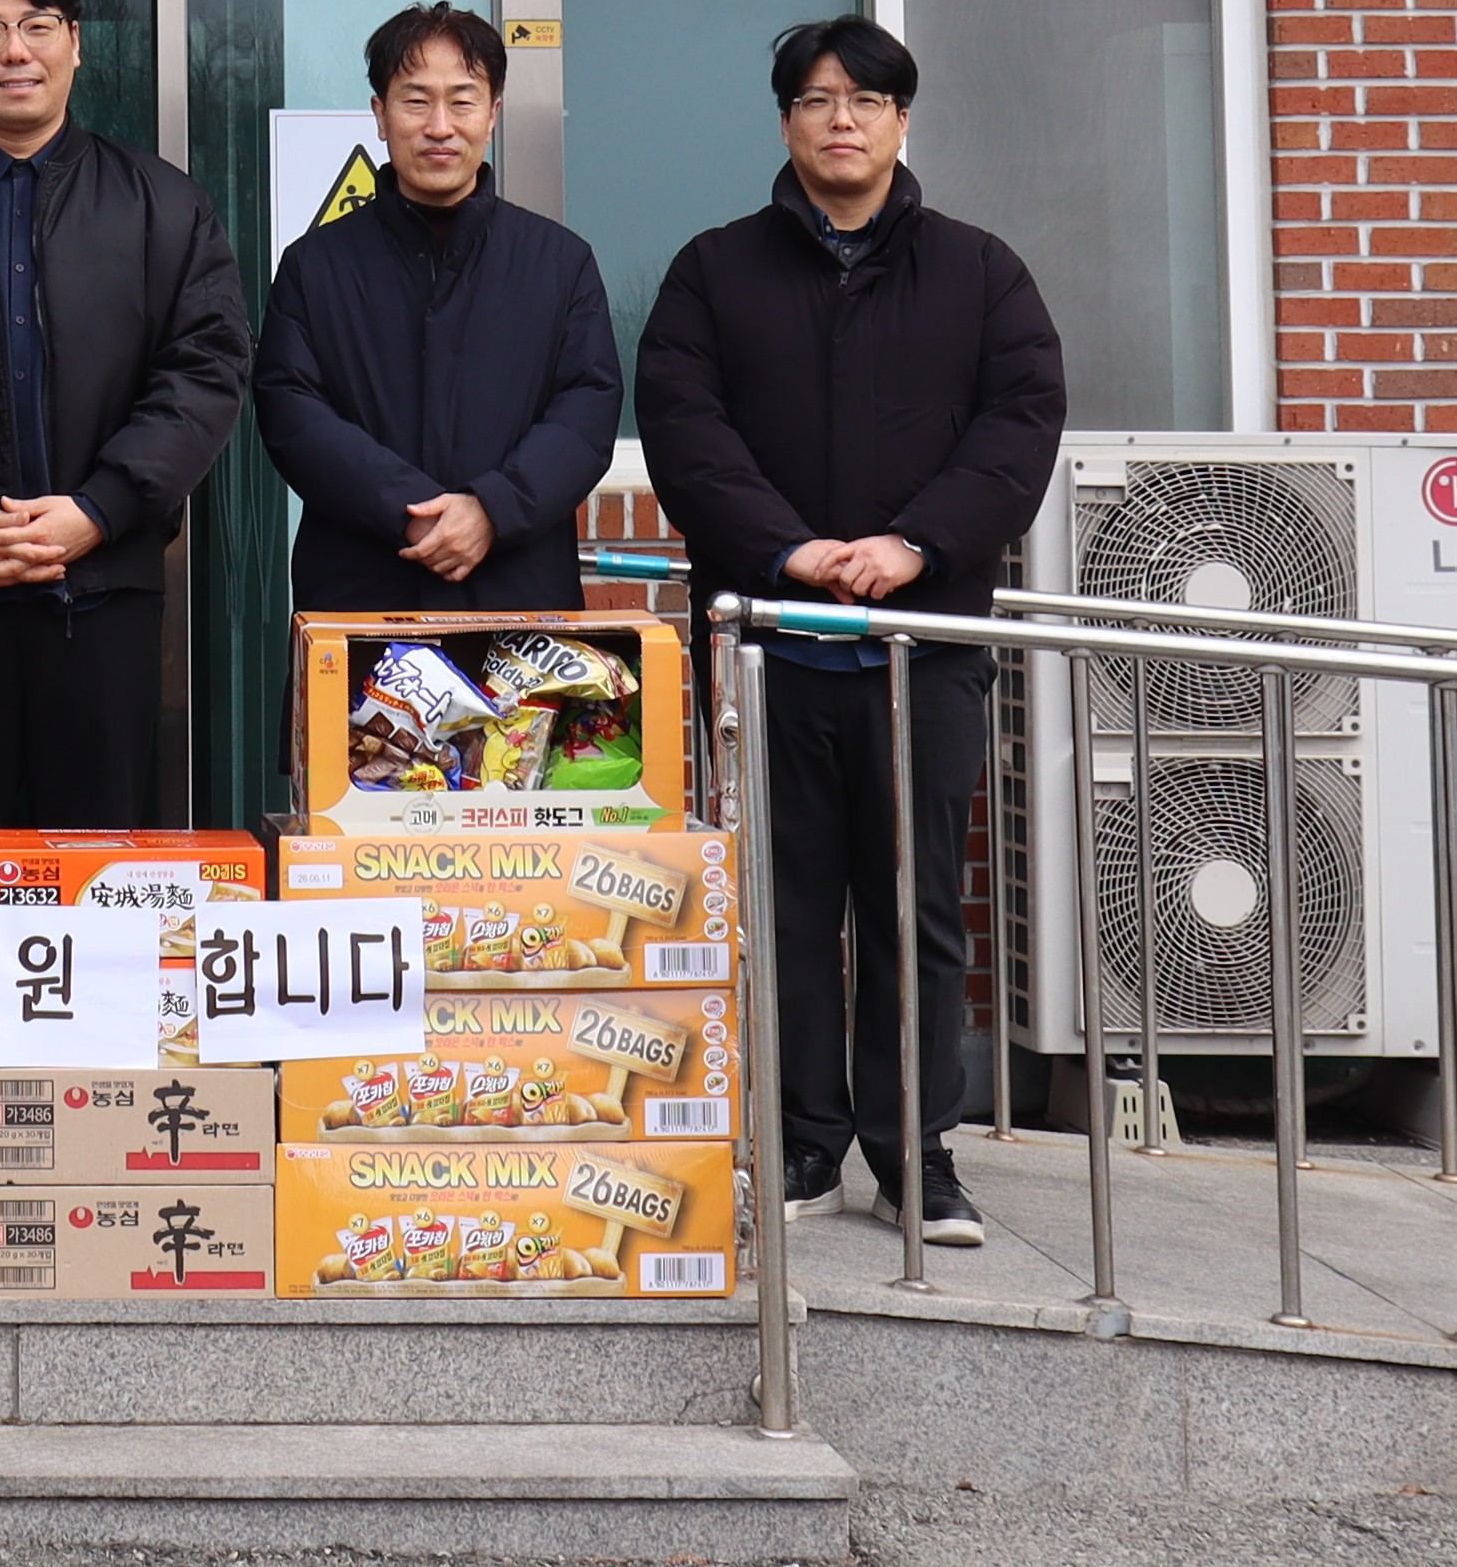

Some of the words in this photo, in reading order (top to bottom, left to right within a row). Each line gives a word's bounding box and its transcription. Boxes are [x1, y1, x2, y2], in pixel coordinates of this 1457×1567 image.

[409, 809, 437, 825] 고메
[461, 808, 528, 827] 크리스피
[534, 807, 583, 827] 핫도그
[599, 806, 629, 823] No.1
[354, 843, 483, 880] SNACK
[489, 843, 562, 880] MIX
[21, 865, 60, 880] 농심
[0, 887, 59, 905] 가3632
[199, 925, 411, 1021] 합니다
[423, 998, 483, 1034] CK
[489, 998, 562, 1034] MIX
[410, 1076, 453, 1094] 포카칩
[91, 1089, 135, 1107] 농심
[7, 1105, 52, 1123] 가3486
[148, 1078, 210, 1163] 辛
[202, 1122, 240, 1138] 라면
[349, 1152, 478, 1189] SNACK
[484, 1152, 560, 1189] MIX
[96, 1209, 140, 1227] 농심
[8, 1225, 53, 1244] 가3486
[152, 1198, 215, 1284] 辛
[405, 1230, 447, 1247] 포카칩
[207, 1241, 245, 1258] 라면
